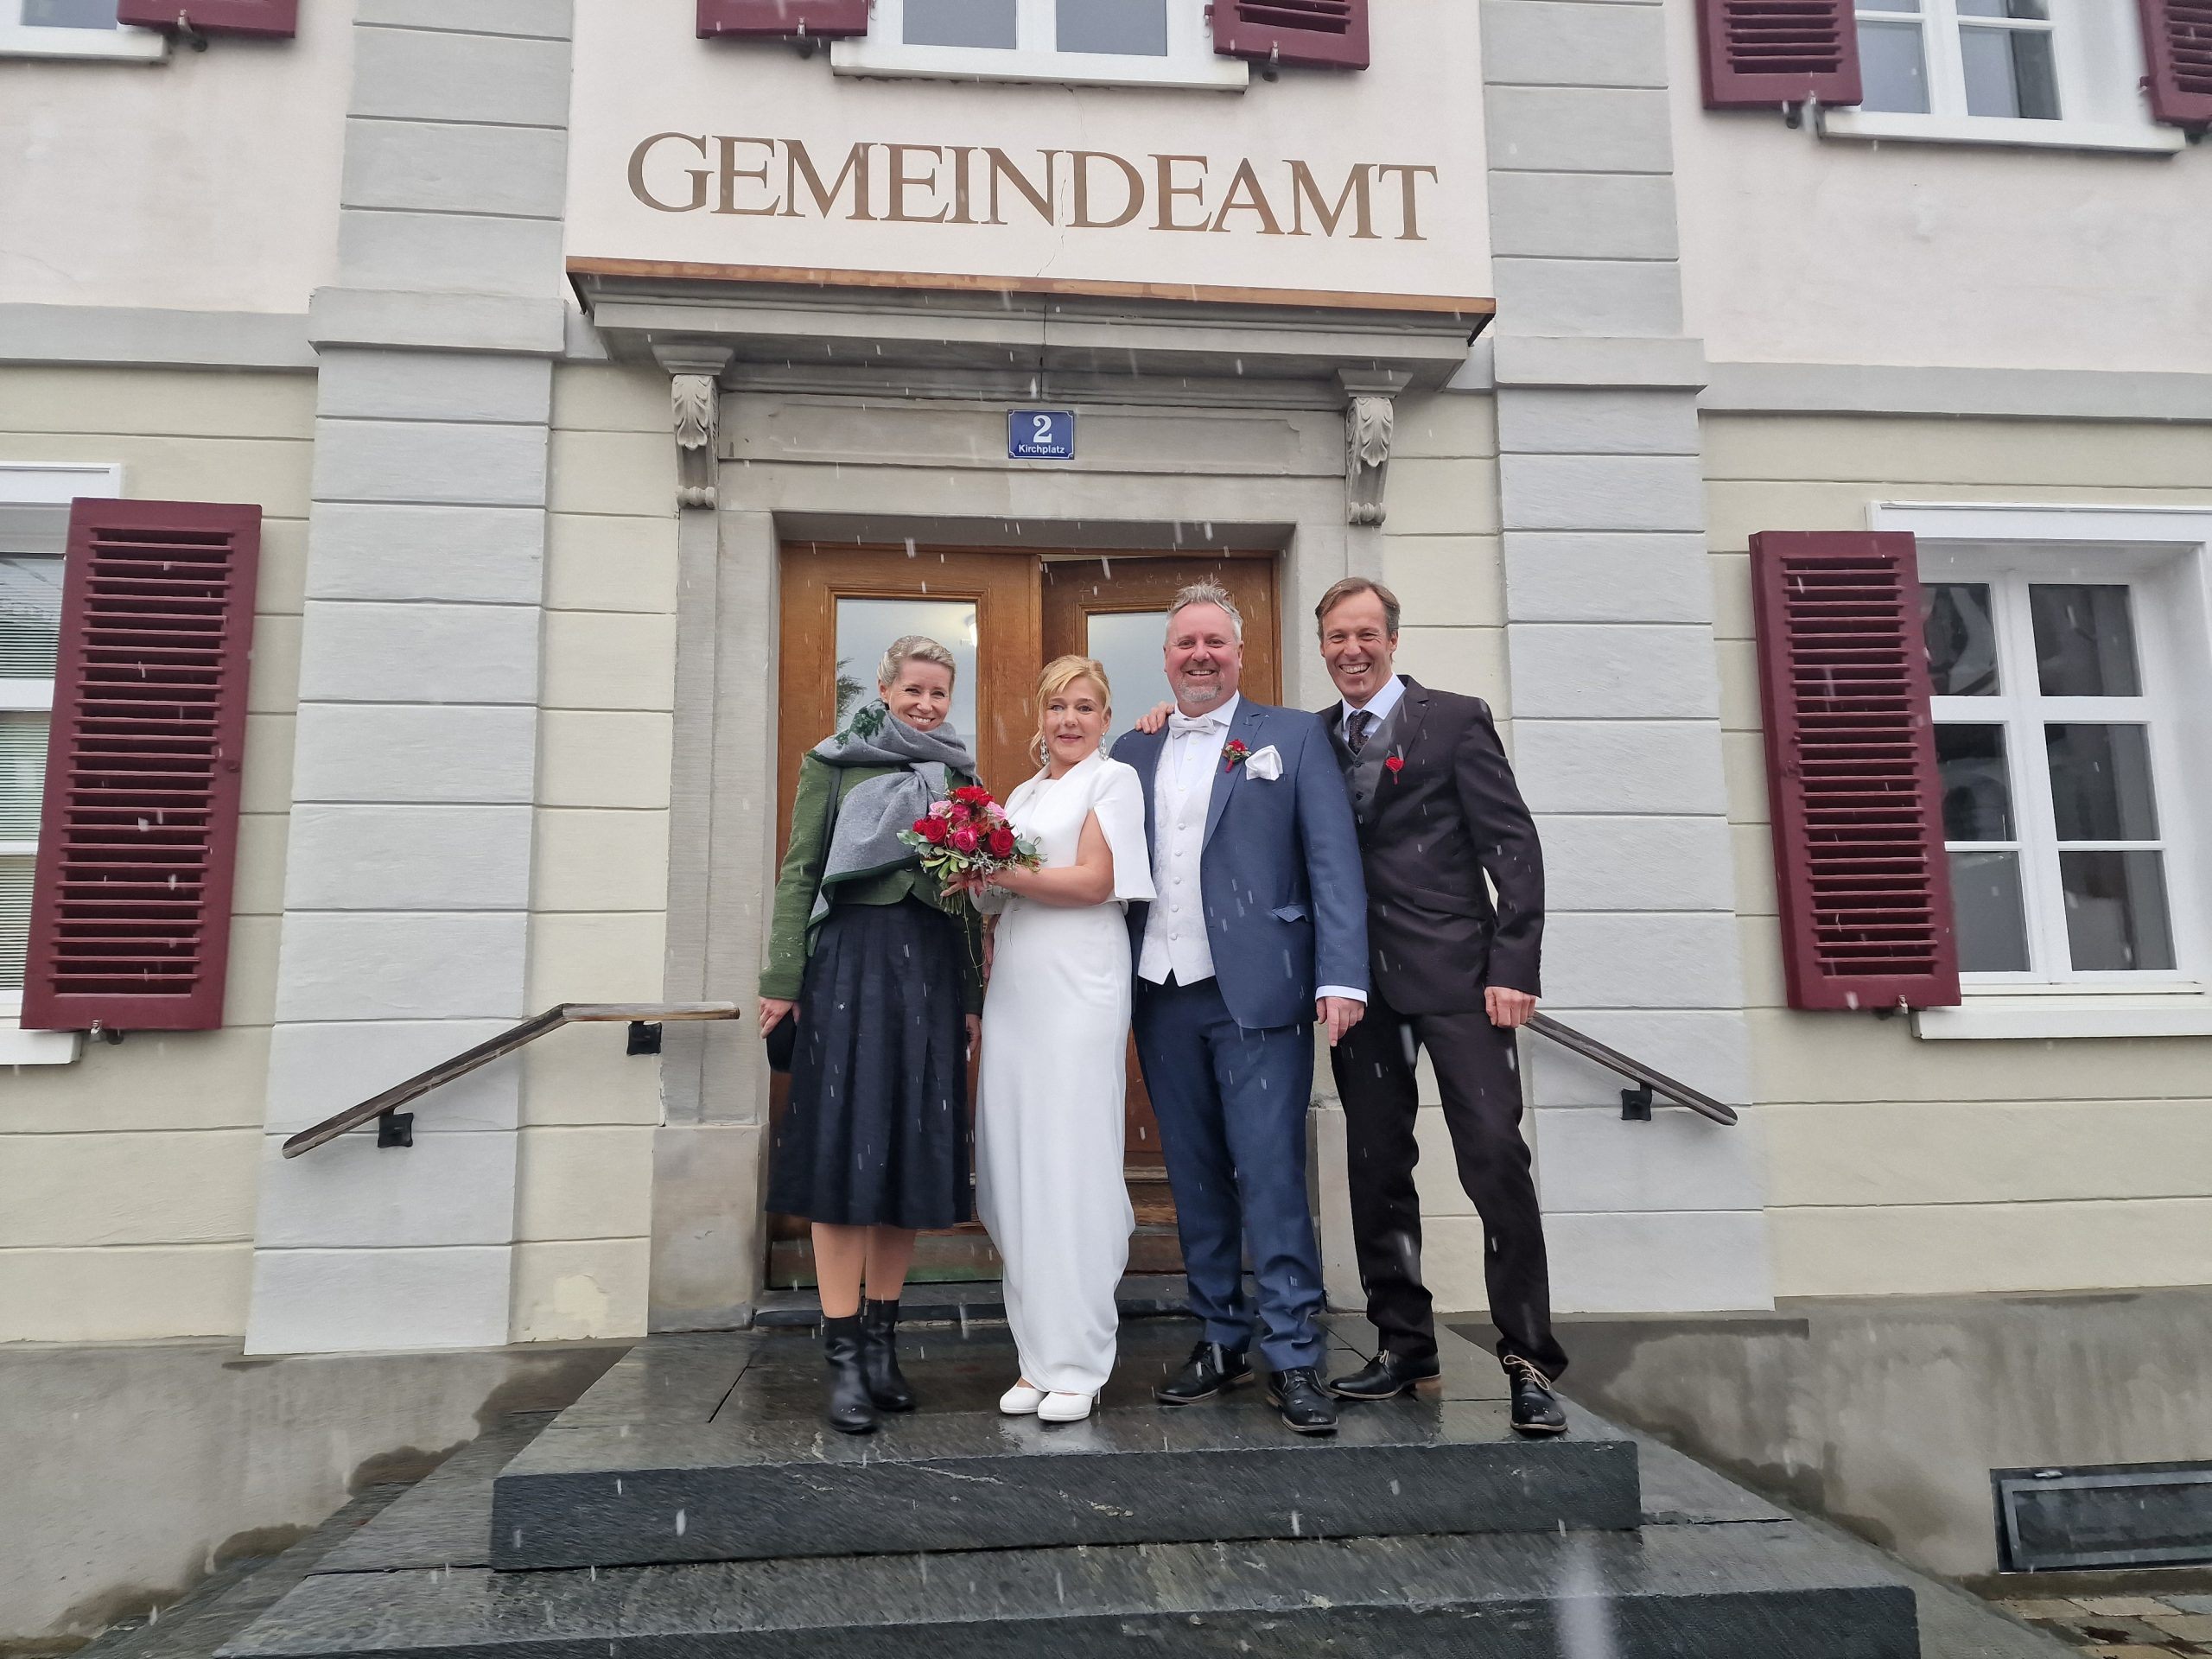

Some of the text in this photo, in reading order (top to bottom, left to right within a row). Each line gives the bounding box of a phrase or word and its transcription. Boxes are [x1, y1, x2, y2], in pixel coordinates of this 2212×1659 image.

[627, 131, 1438, 240] GEMEINDEAMT
[1033, 415, 1052, 442] 2
[1018, 444, 1065, 454] Kirchplatz
